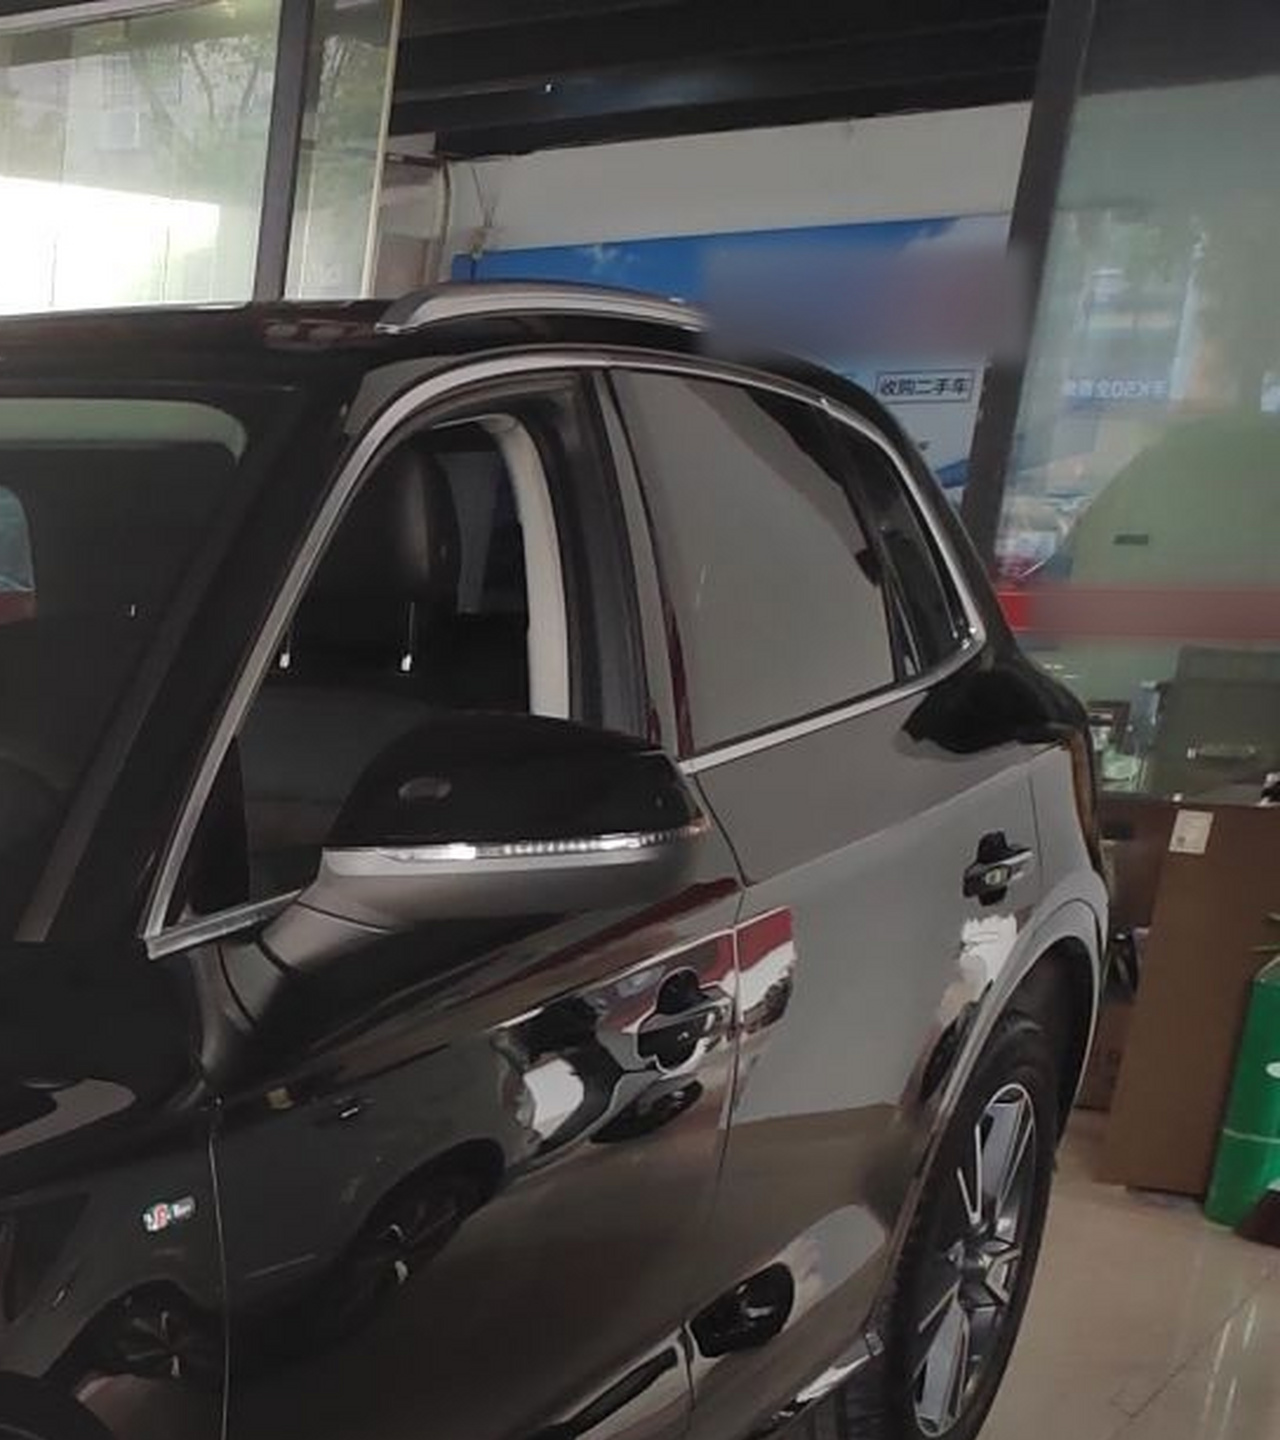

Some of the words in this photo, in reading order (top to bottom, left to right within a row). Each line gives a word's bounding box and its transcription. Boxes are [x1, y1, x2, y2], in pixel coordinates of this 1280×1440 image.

[879, 377, 971, 396] 收购二手车
